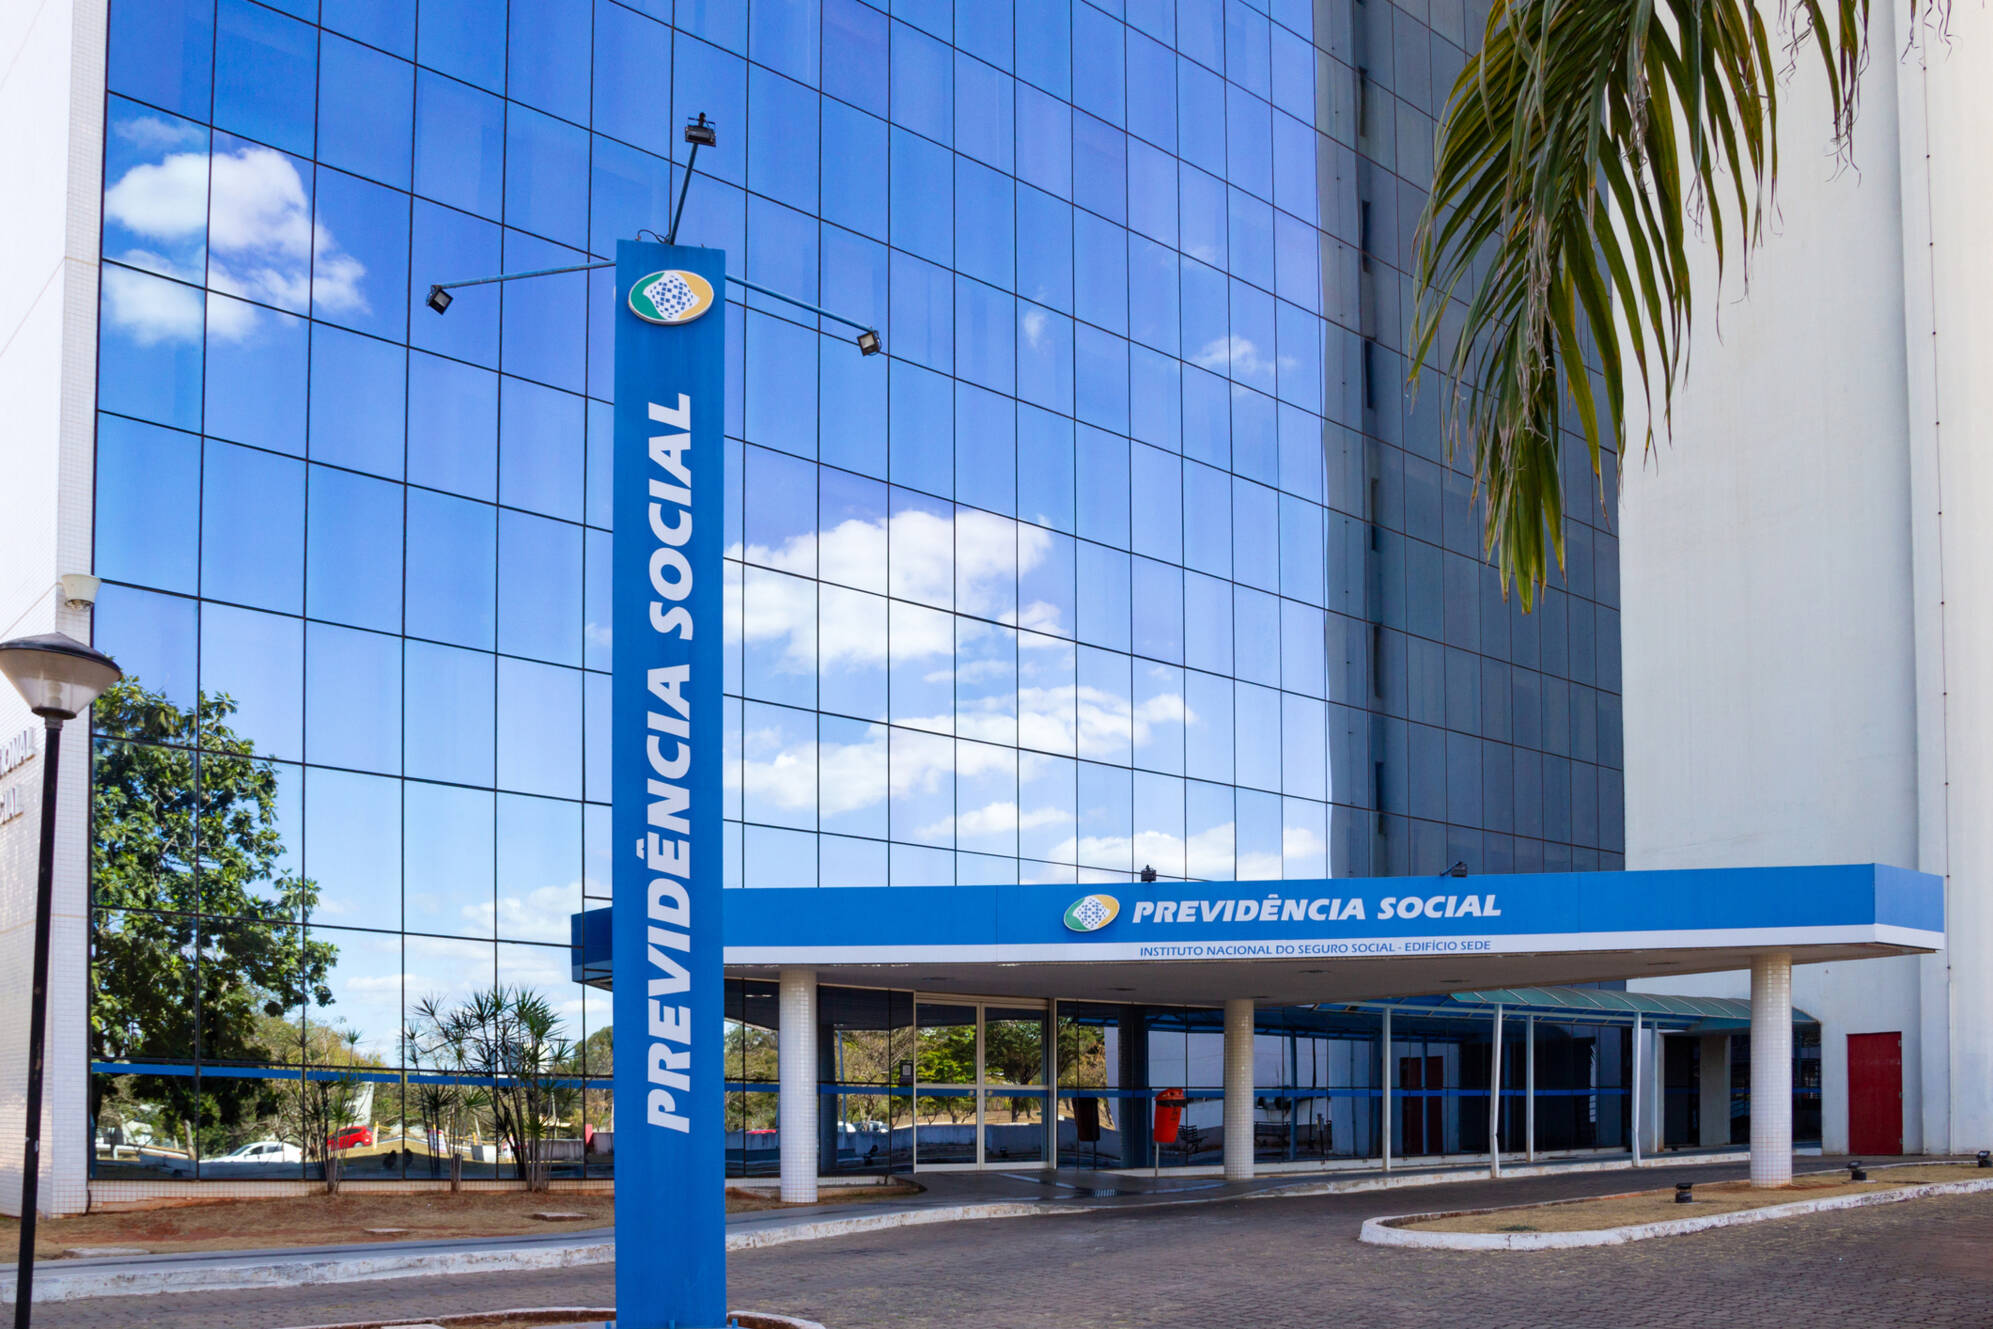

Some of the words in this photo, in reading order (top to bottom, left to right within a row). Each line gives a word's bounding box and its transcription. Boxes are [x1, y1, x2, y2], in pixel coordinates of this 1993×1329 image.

[648, 393, 693, 641] SOCIAL
[637, 664, 692, 1133] PREVIDÊNCIA
[1132, 894, 1366, 923] PREVIDÊNCIA
[1377, 894, 1501, 920] SOCIAL
[1140, 946, 1203, 957] INSTITUTO
[1206, 945, 1272, 955] NACIONAL
[1276, 944, 1295, 954] DO
[1299, 943, 1348, 955] SEGURO
[1351, 942, 1396, 953] SOCIAL
[1405, 940, 1458, 952] EDIFÍCIO
[1461, 940, 1491, 950] SEDE
